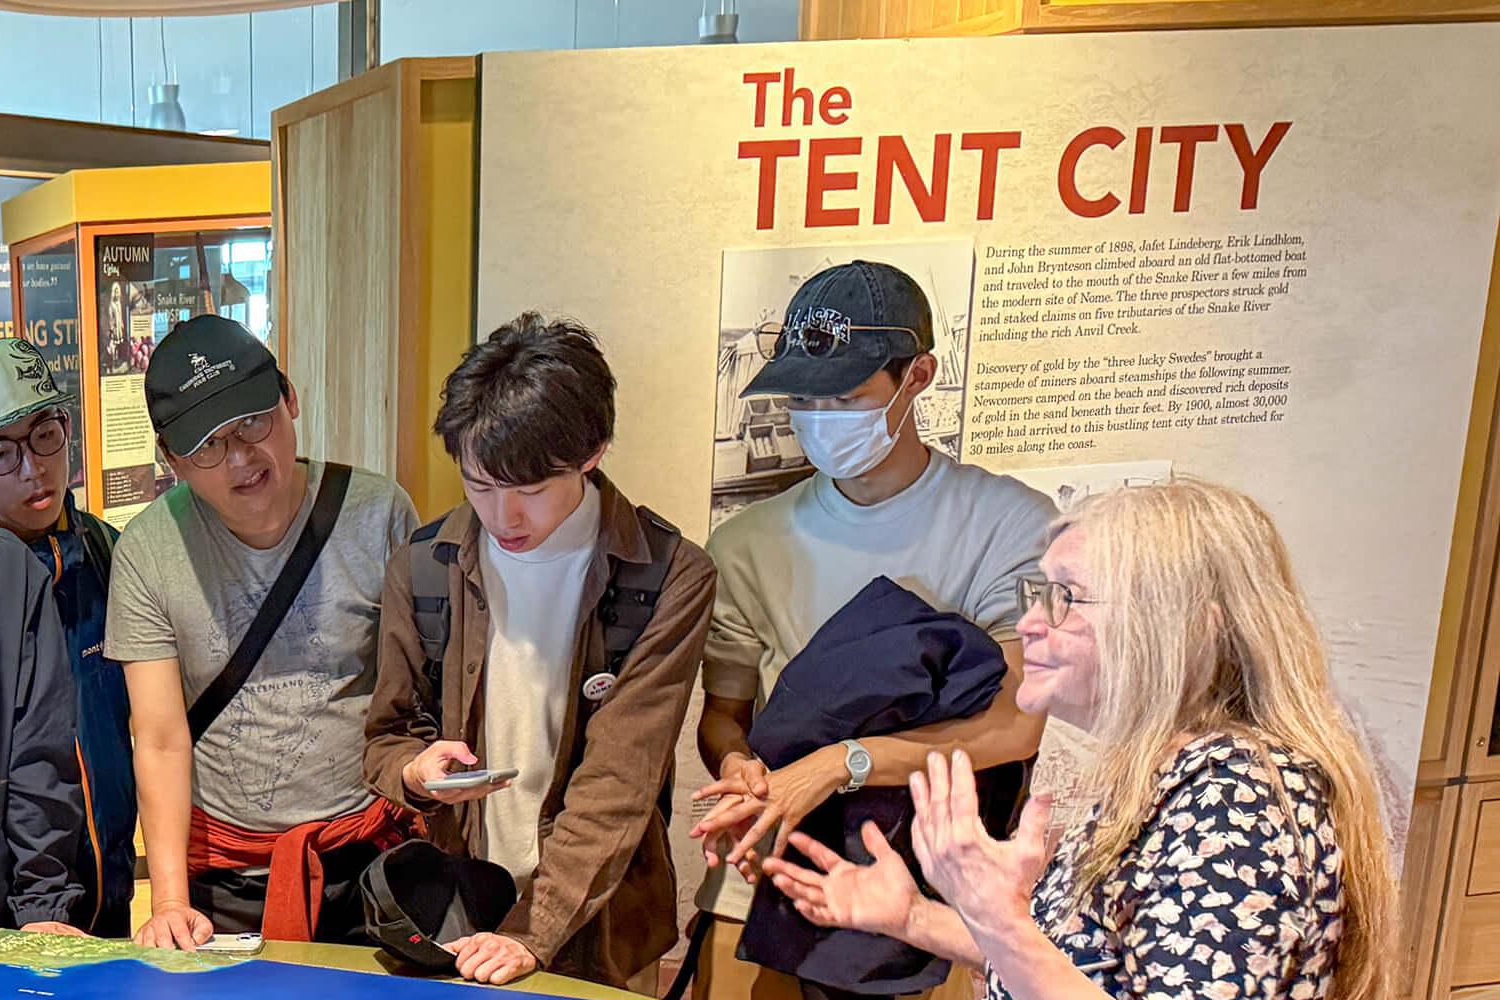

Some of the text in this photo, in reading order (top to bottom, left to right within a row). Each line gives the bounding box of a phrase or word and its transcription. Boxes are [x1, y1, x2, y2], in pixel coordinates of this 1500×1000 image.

[742, 67, 852, 128] The
[737, 121, 1294, 230] TENT CITY
[103, 246, 150, 262] AUTUMN
[985, 245, 1025, 261] During
[1027, 244, 1045, 257] the
[1047, 246, 1092, 256] summer
[1093, 242, 1104, 254] of
[1107, 241, 1136, 255] 1898,
[1225, 236, 1252, 248] Erik
[983, 263, 1004, 275] and
[1006, 261, 1034, 274] John
[1093, 257, 1136, 270] climbed
[1137, 255, 1175, 268] aboard
[1177, 258, 1192, 266] an
[1193, 254, 1210, 266] old
[1211, 250, 1282, 265] flat-bottomed
[1283, 249, 1307, 262] boat
[982, 265, 1307, 291] and traveled to the mouth of the Snake River a few miles from
[981, 282, 1288, 308] the modern site of Nome. The three prospectors struck gold
[979, 299, 1271, 325] and staked claims on five tributaries of the Snake River
[978, 322, 1141, 344] including the rich Anvil Creek.
[976, 360, 1028, 378] Discovery
[1028, 360, 1040, 372] of
[1042, 358, 1065, 374] gold
[1066, 357, 1080, 373] by
[1082, 356, 1100, 369] the
[1137, 353, 1166, 369] lucky
[1212, 348, 1254, 364] brought
[1254, 351, 1263, 359] a
[972, 378, 1289, 407] Newcomers camped on the beach and discovered rich deposits
[973, 377, 1025, 394] stampede
[1026, 376, 1037, 388] of
[1039, 375, 1077, 387] miners
[1078, 372, 1116, 385] aboard
[1117, 368, 1177, 386] steamships
[1178, 367, 1197, 380] the
[1198, 365, 1245, 382] following
[971, 411, 982, 423] of
[984, 410, 1006, 425] gold
[1008, 410, 1020, 421] in
[1022, 408, 1040, 420] the
[1042, 406, 1068, 419] sand
[1070, 404, 1112, 417] beneath
[1113, 402, 1140, 415] their
[1166, 400, 1184, 415] By
[1185, 398, 1213, 412] 1900,
[1214, 396, 1250, 409] almost
[1251, 394, 1287, 409] 30,000
[970, 409, 1284, 442] people had arrived to this bustling tent city that stretched for
[969, 439, 1097, 456] 30 miles along the coast.
